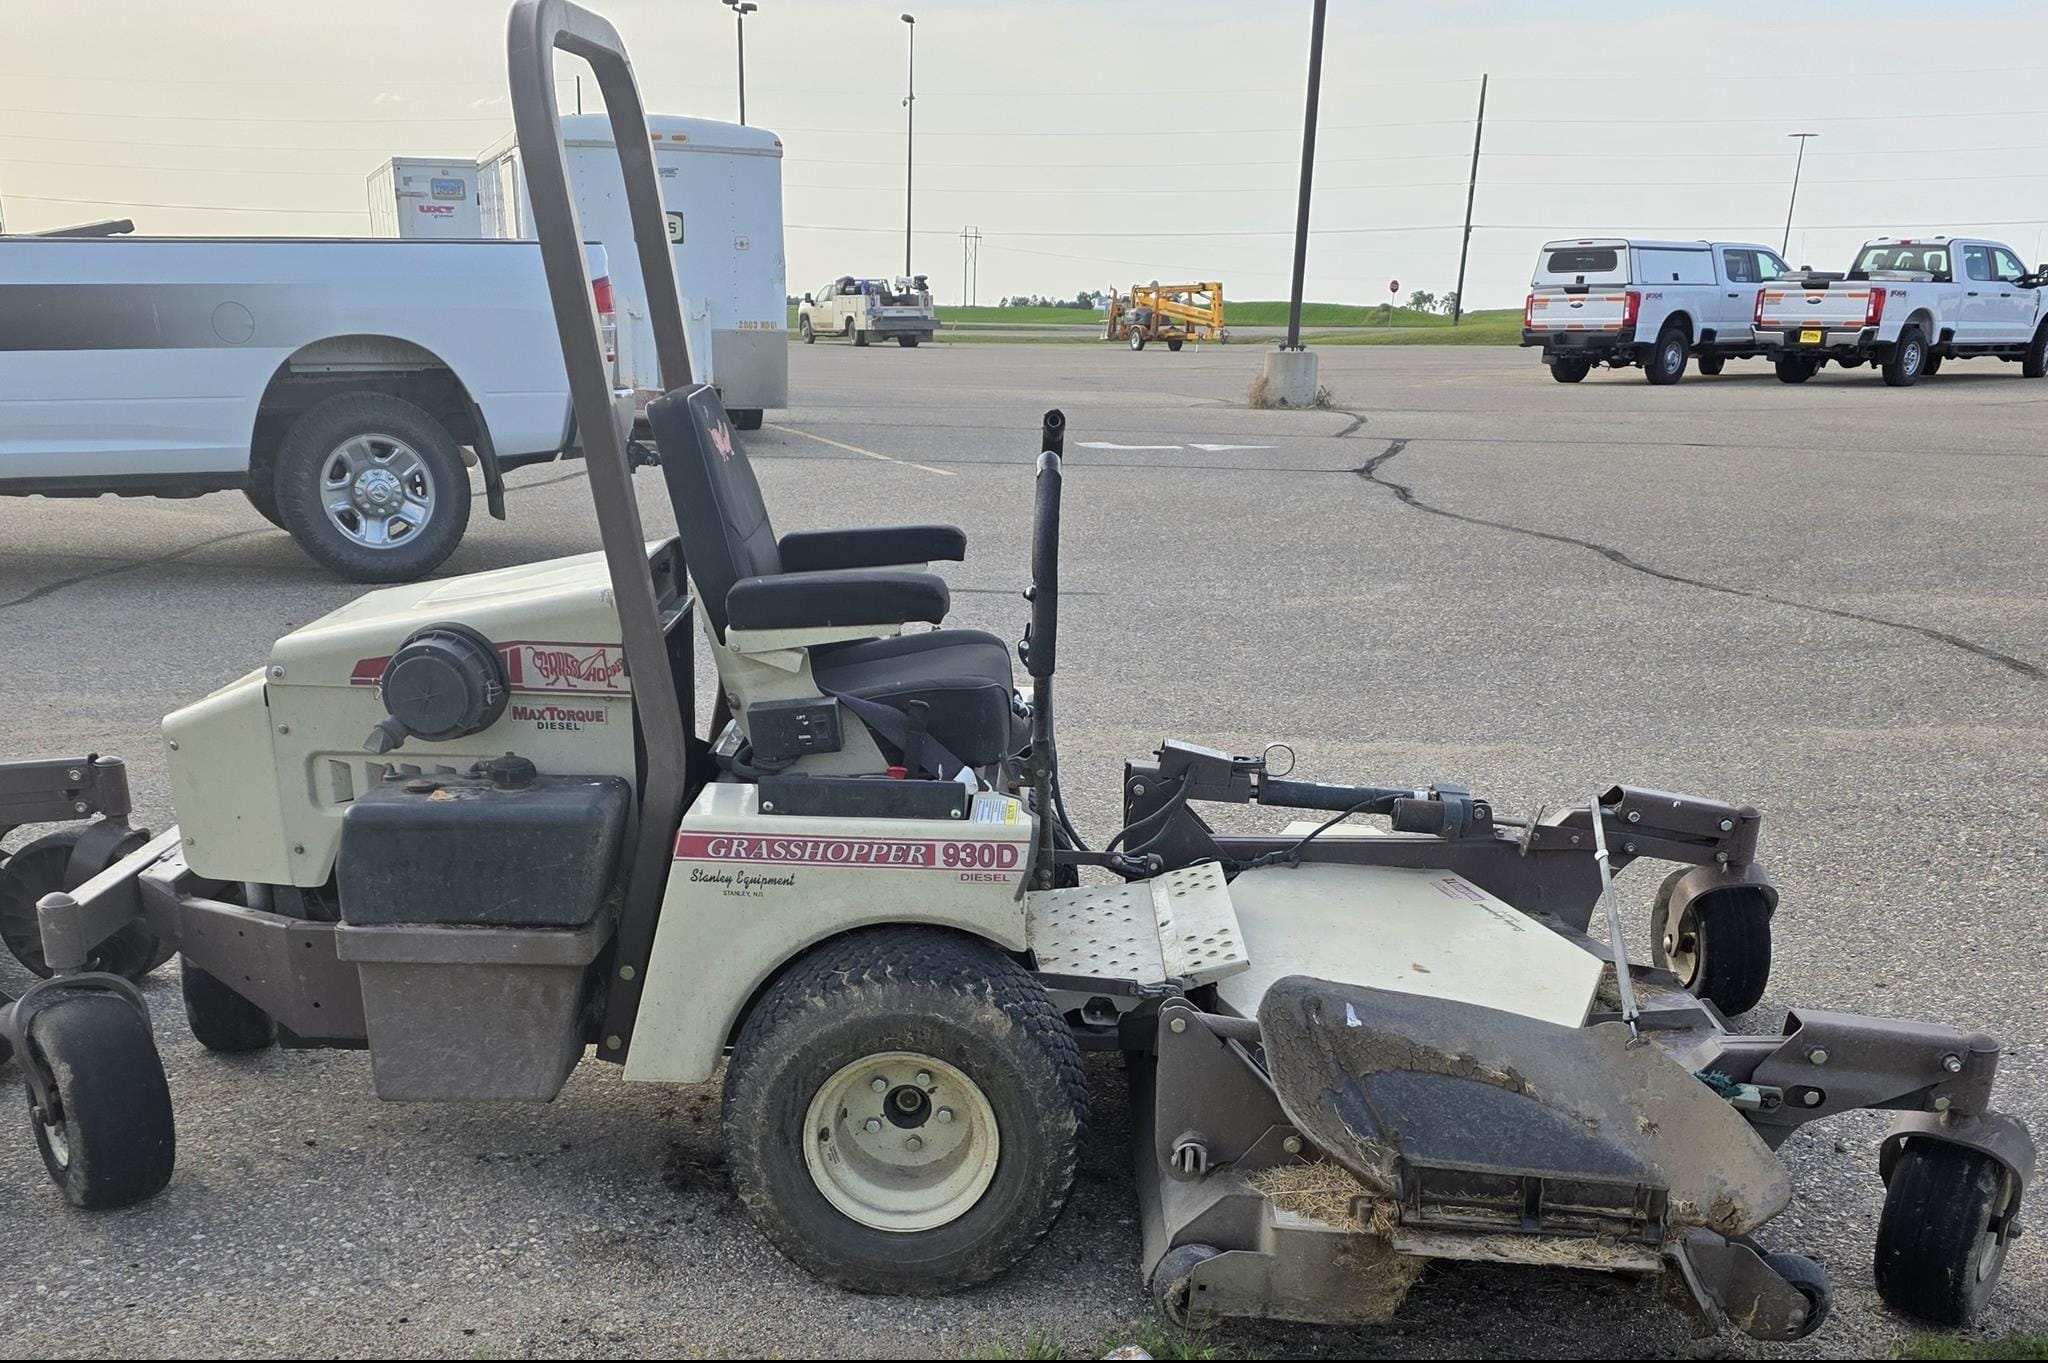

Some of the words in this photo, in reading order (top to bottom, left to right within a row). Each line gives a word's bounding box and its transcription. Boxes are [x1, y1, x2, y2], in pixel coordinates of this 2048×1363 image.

[537, 721, 580, 730] DIESEL
[706, 837, 927, 865] GRASSHOPPER
[942, 842, 1019, 868] 930D
[690, 868, 733, 889] Stanley
[736, 870, 796, 890] Equipment
[960, 873, 1011, 882] DIESEL
